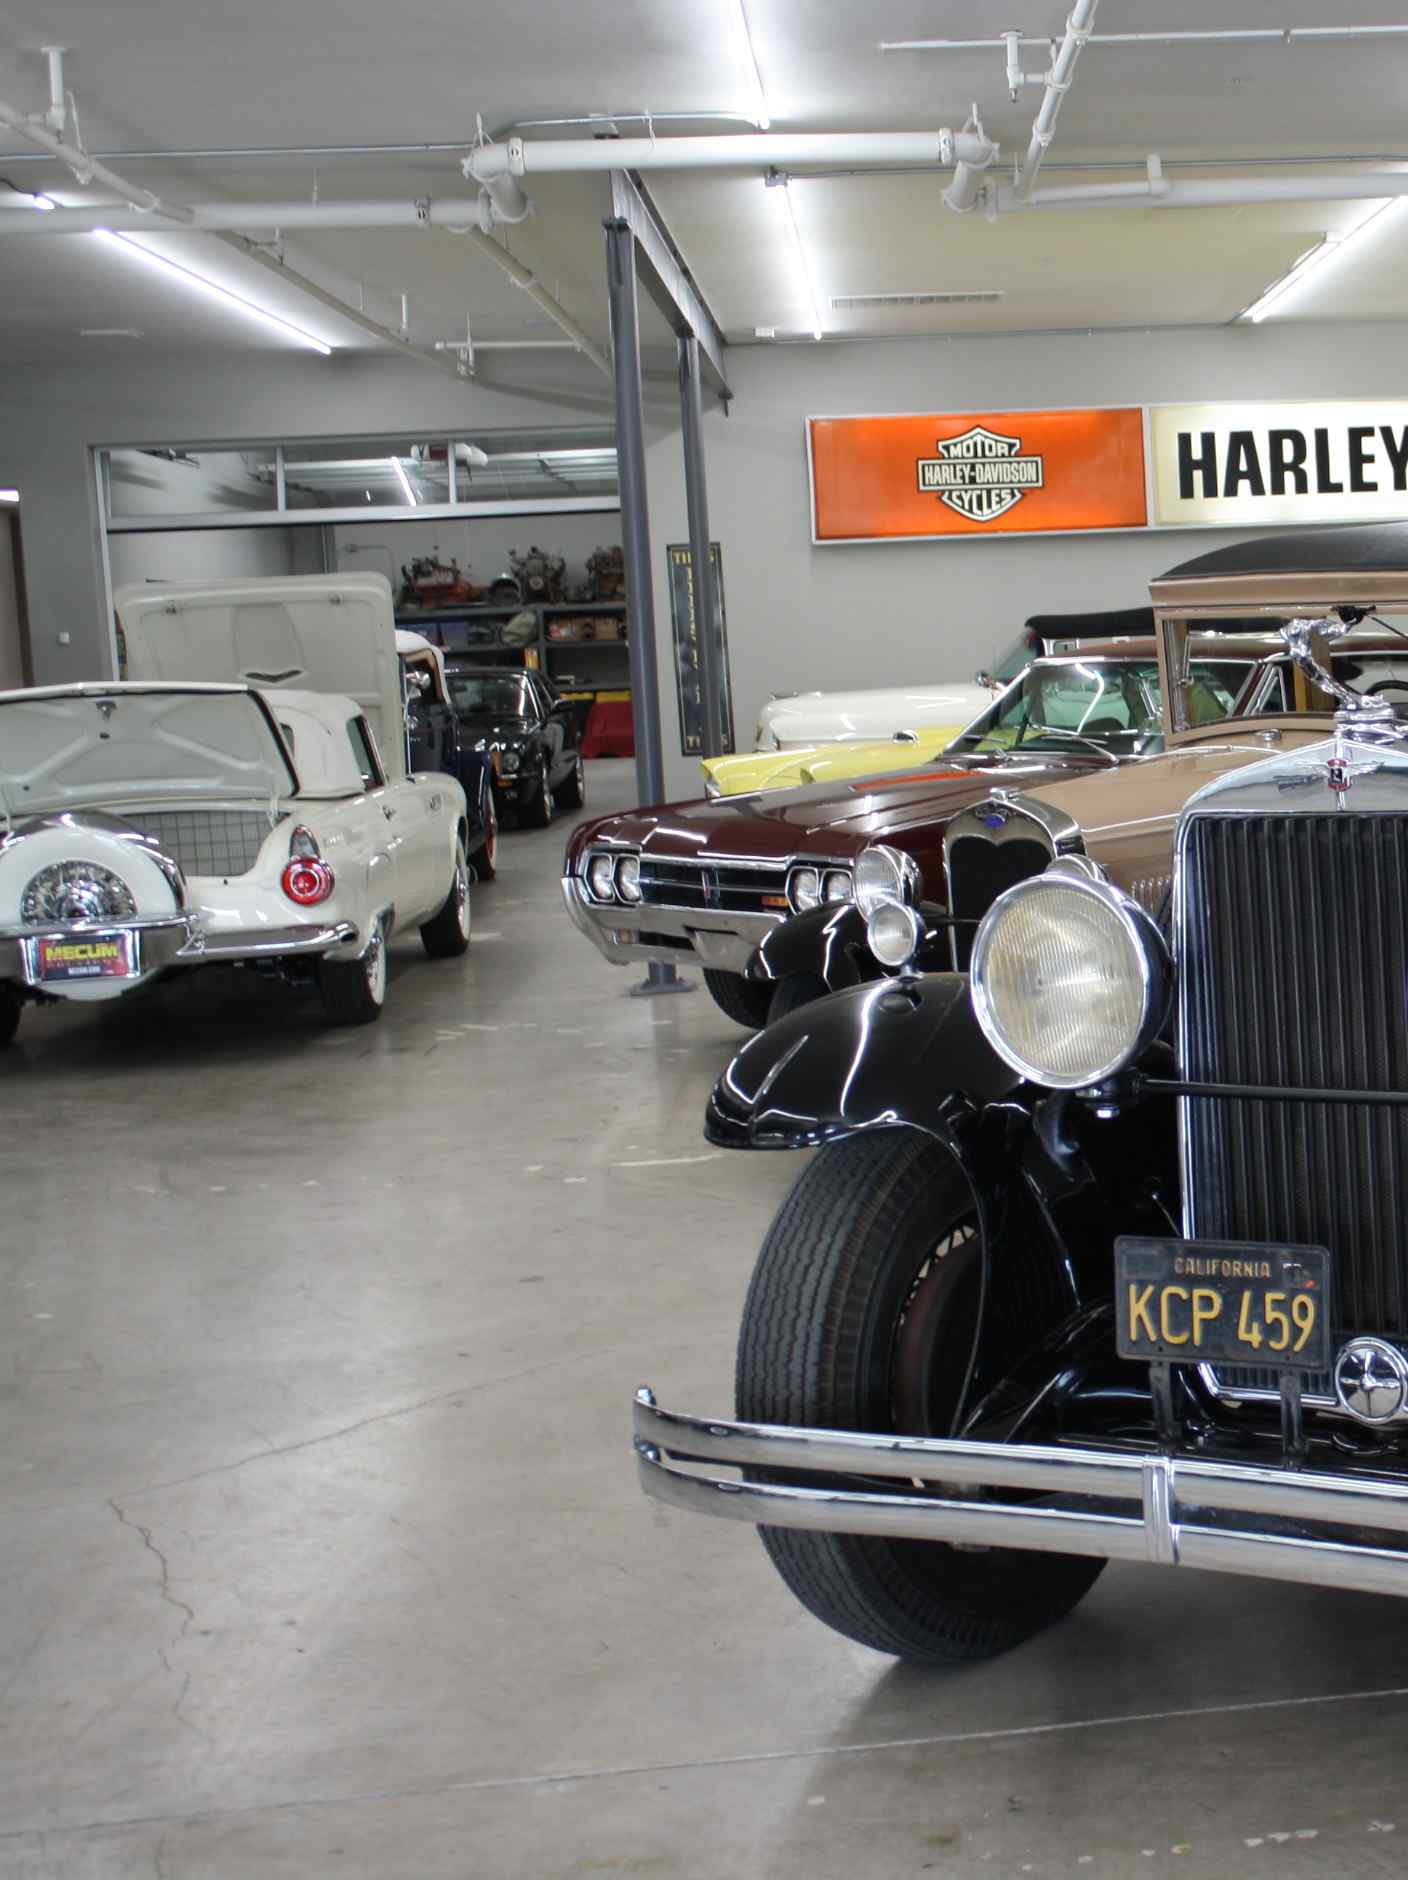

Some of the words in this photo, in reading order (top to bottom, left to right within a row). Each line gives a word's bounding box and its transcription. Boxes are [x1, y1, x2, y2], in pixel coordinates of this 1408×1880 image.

[948, 434, 1009, 458] MOTOR
[924, 461, 1037, 485] HARLEY-DAVIDSON
[951, 488, 1012, 515] CYCLES
[45, 943, 118, 961] MECUM
[1174, 1257, 1271, 1278] CALIFORNIA
[1128, 1283, 1222, 1346] KCP
[1237, 1290, 1315, 1353] 459
